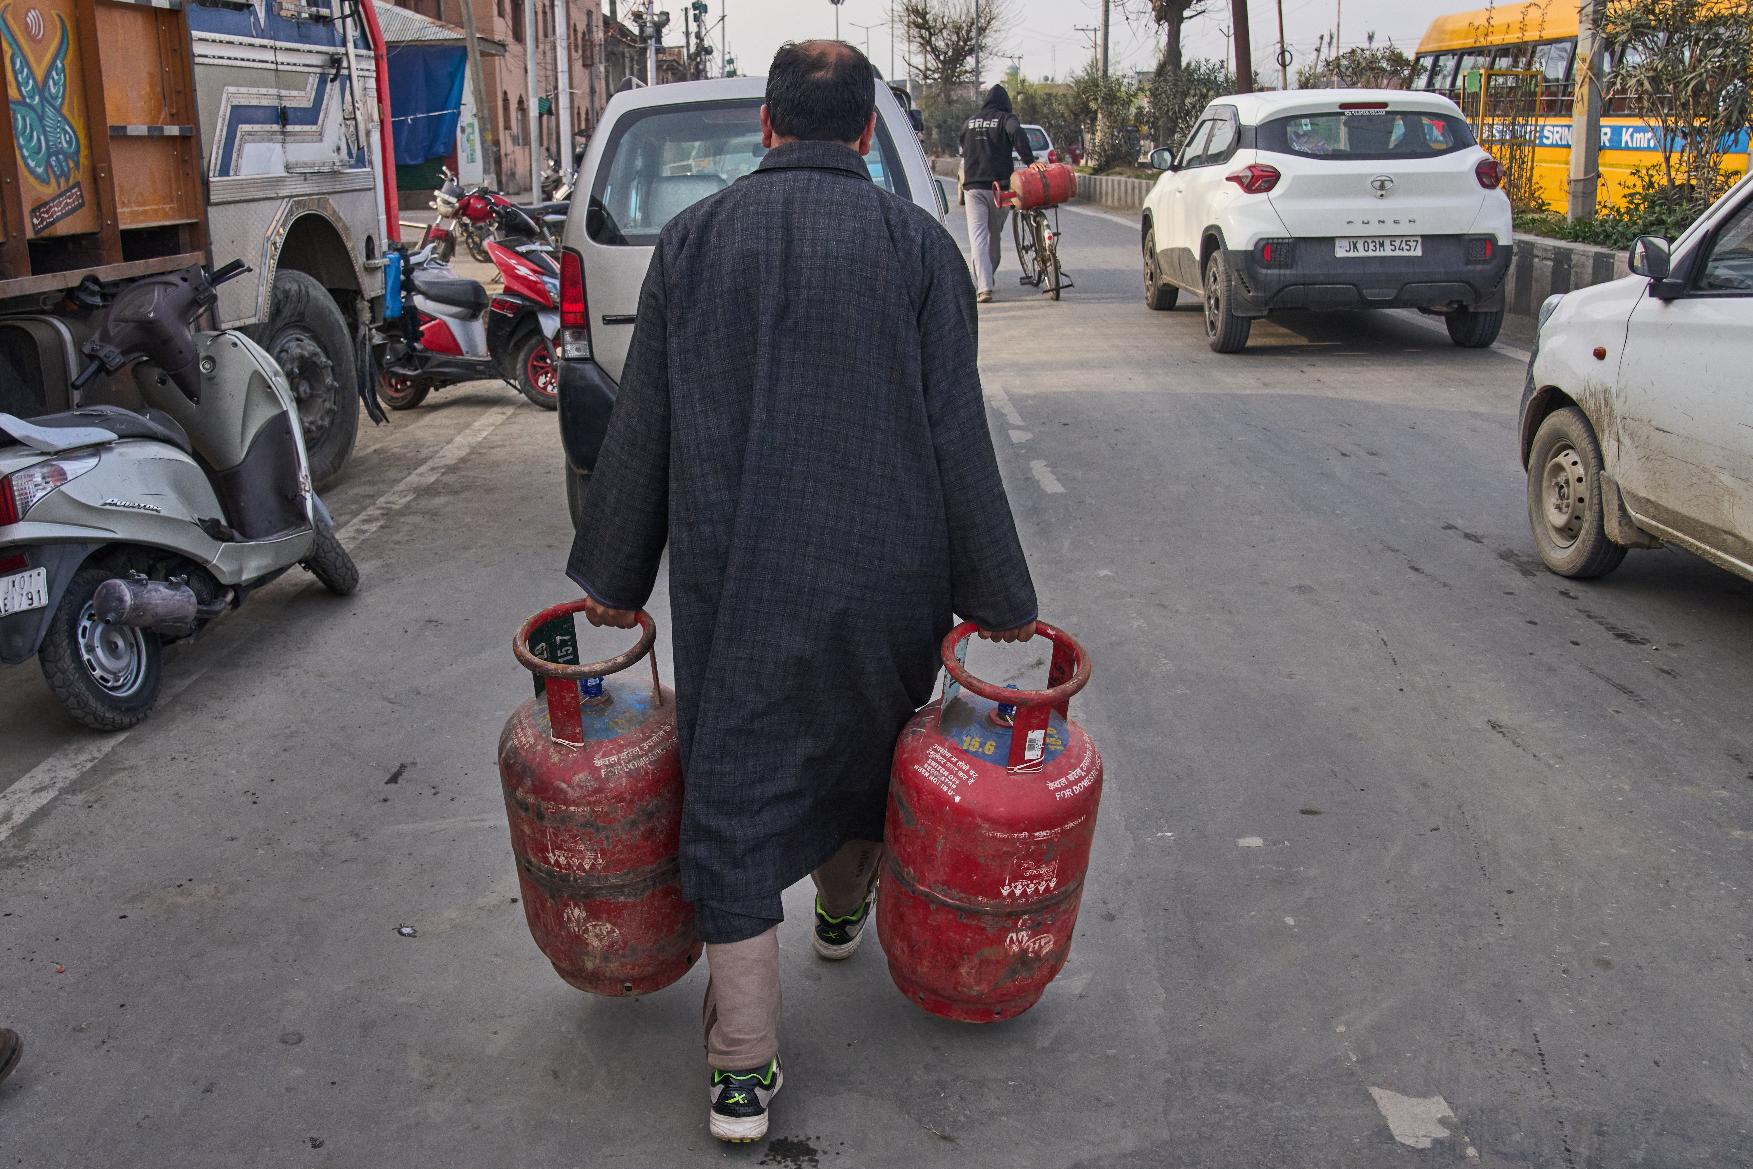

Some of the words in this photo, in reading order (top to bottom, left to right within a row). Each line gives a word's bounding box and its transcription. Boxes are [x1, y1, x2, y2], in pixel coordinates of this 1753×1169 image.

[1345, 240, 1359, 252] JK
[1362, 240, 1385, 252] 03M
[1389, 240, 1419, 252] 5457
[963, 735, 996, 755] 15.6
[927, 758, 949, 776] SWITCH
[1046, 777, 1068, 791] केवल
[1055, 789, 1074, 801] FOR
